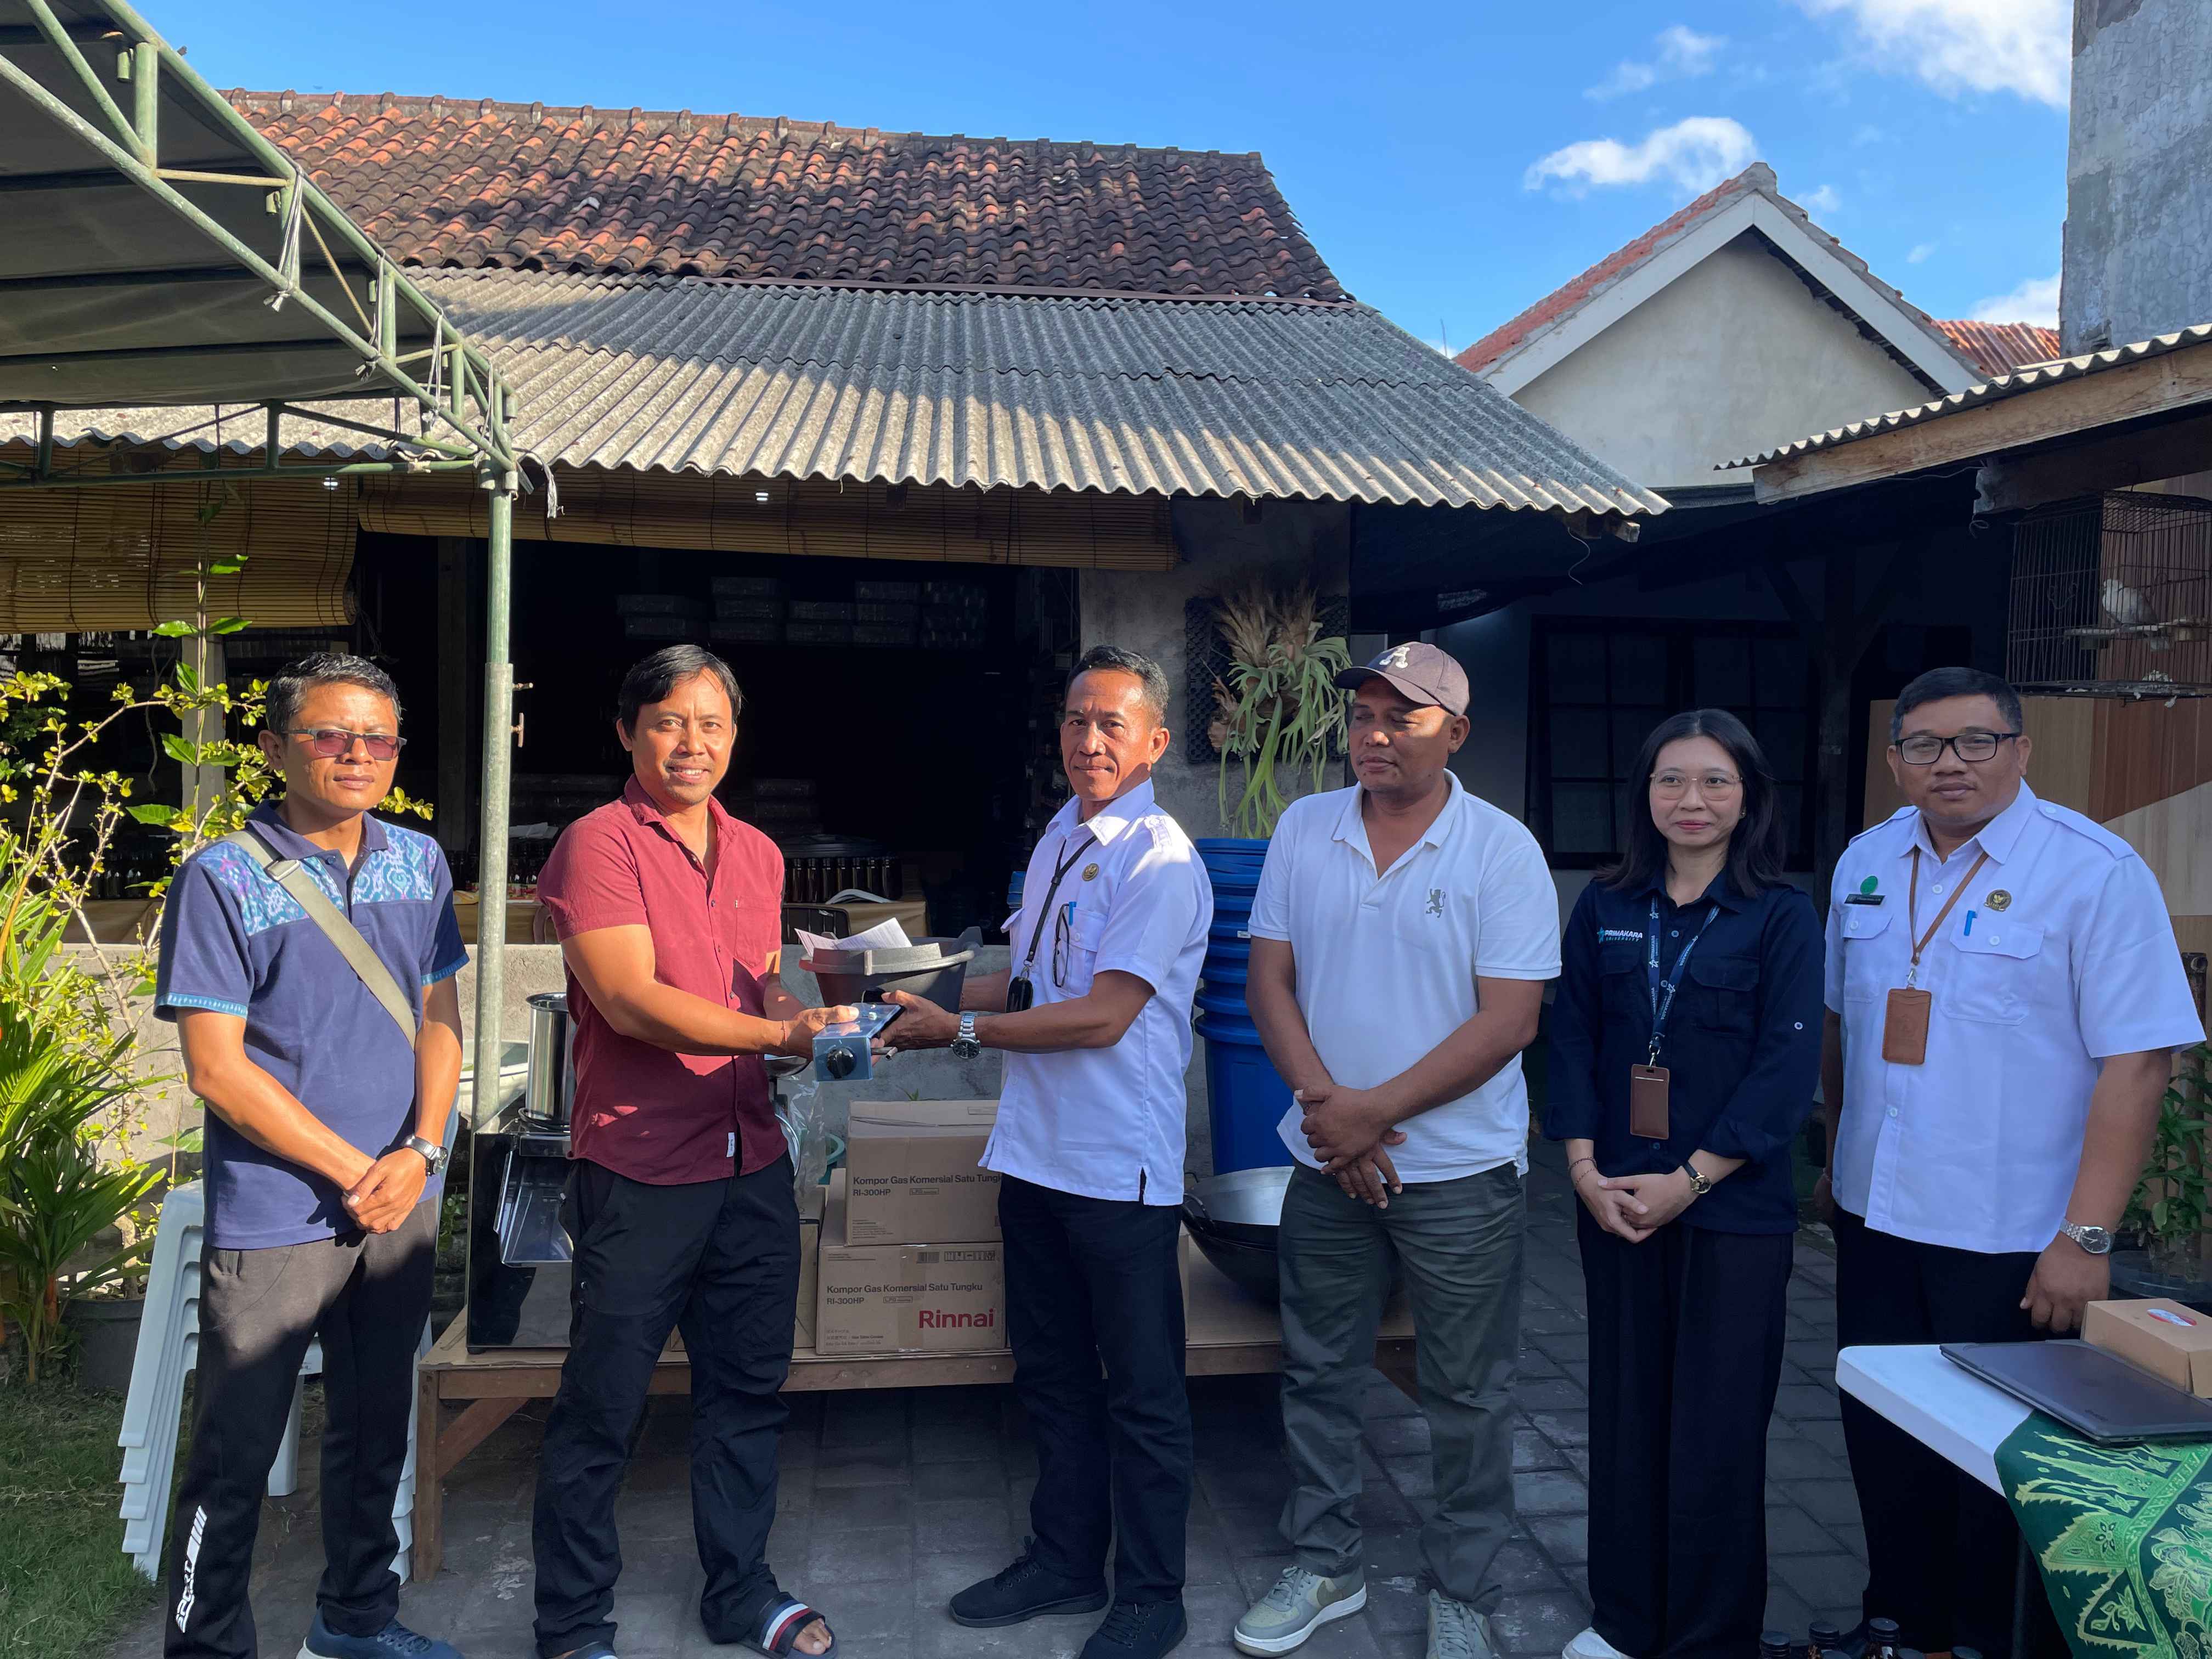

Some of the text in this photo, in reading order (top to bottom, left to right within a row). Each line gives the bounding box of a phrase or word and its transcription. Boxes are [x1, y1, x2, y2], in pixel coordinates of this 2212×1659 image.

[1379, 647, 1410, 668] A
[1605, 930, 1643, 938] PRIMAKARA
[853, 1176, 888, 1186] Kompor
[910, 1175, 953, 1184] Komersial
[955, 1175, 975, 1183] Satu
[827, 1285, 862, 1295] Kompor
[864, 1285, 882, 1293] Gas
[883, 1284, 927, 1293] Komersial
[951, 1283, 983, 1292] Tungku
[919, 1308, 994, 1328] Rinnai
